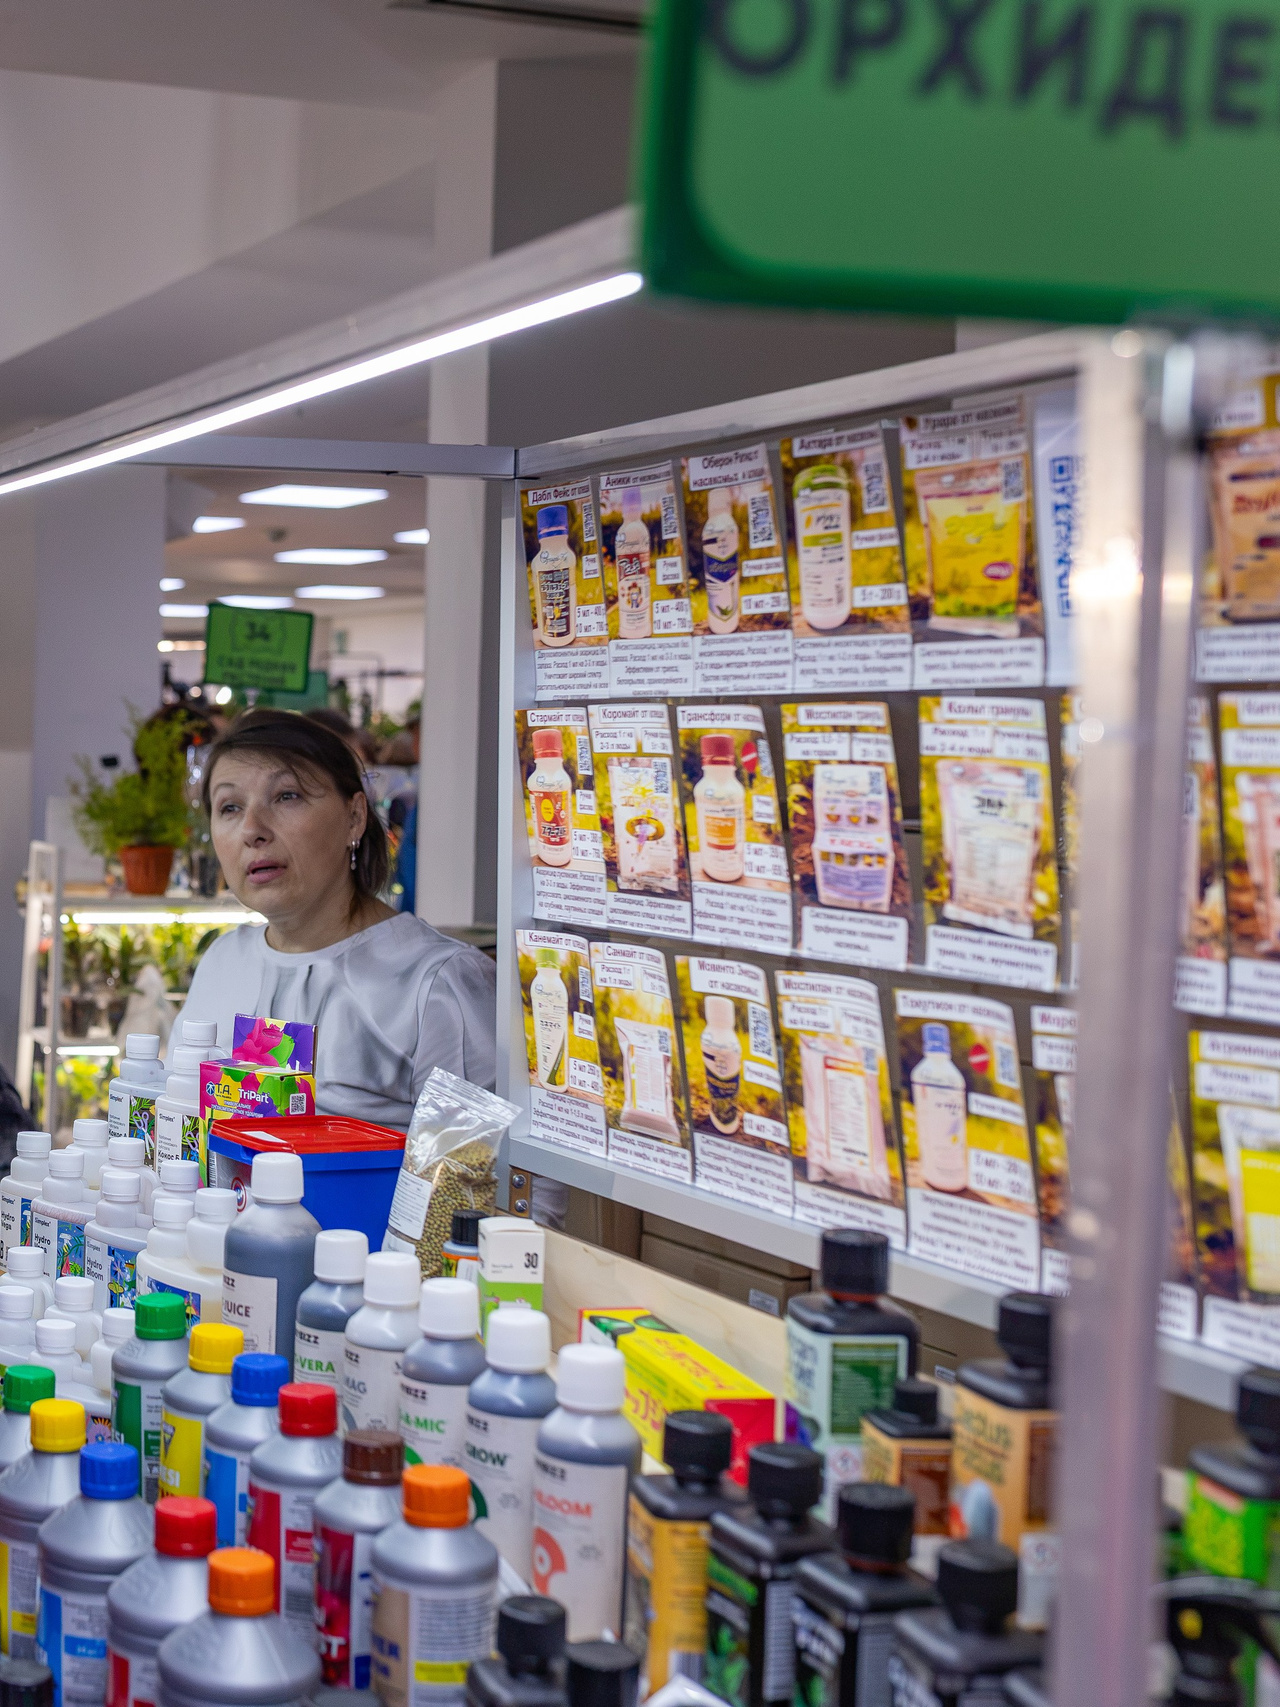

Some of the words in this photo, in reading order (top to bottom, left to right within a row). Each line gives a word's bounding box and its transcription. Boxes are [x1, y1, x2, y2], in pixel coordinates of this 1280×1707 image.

[705, 0, 1280, 150] ОРХИДЕ
[605, 475, 631, 487] Аники
[532, 491, 551, 504] Дабл
[553, 486, 569, 499] Фейс
[530, 712, 562, 722] Стармайт
[529, 932, 563, 945] Канемайт
[238, 1088, 269, 1103] TriPart
[109, 1129, 122, 1137] Кокос
[158, 1151, 174, 1159] Кокос
[1, 1211, 15, 1222] Hydro
[35, 1233, 50, 1245] Hydro
[86, 1257, 102, 1270] Hydro
[524, 1252, 539, 1269] 30
[86, 1267, 104, 1282] Bloom
